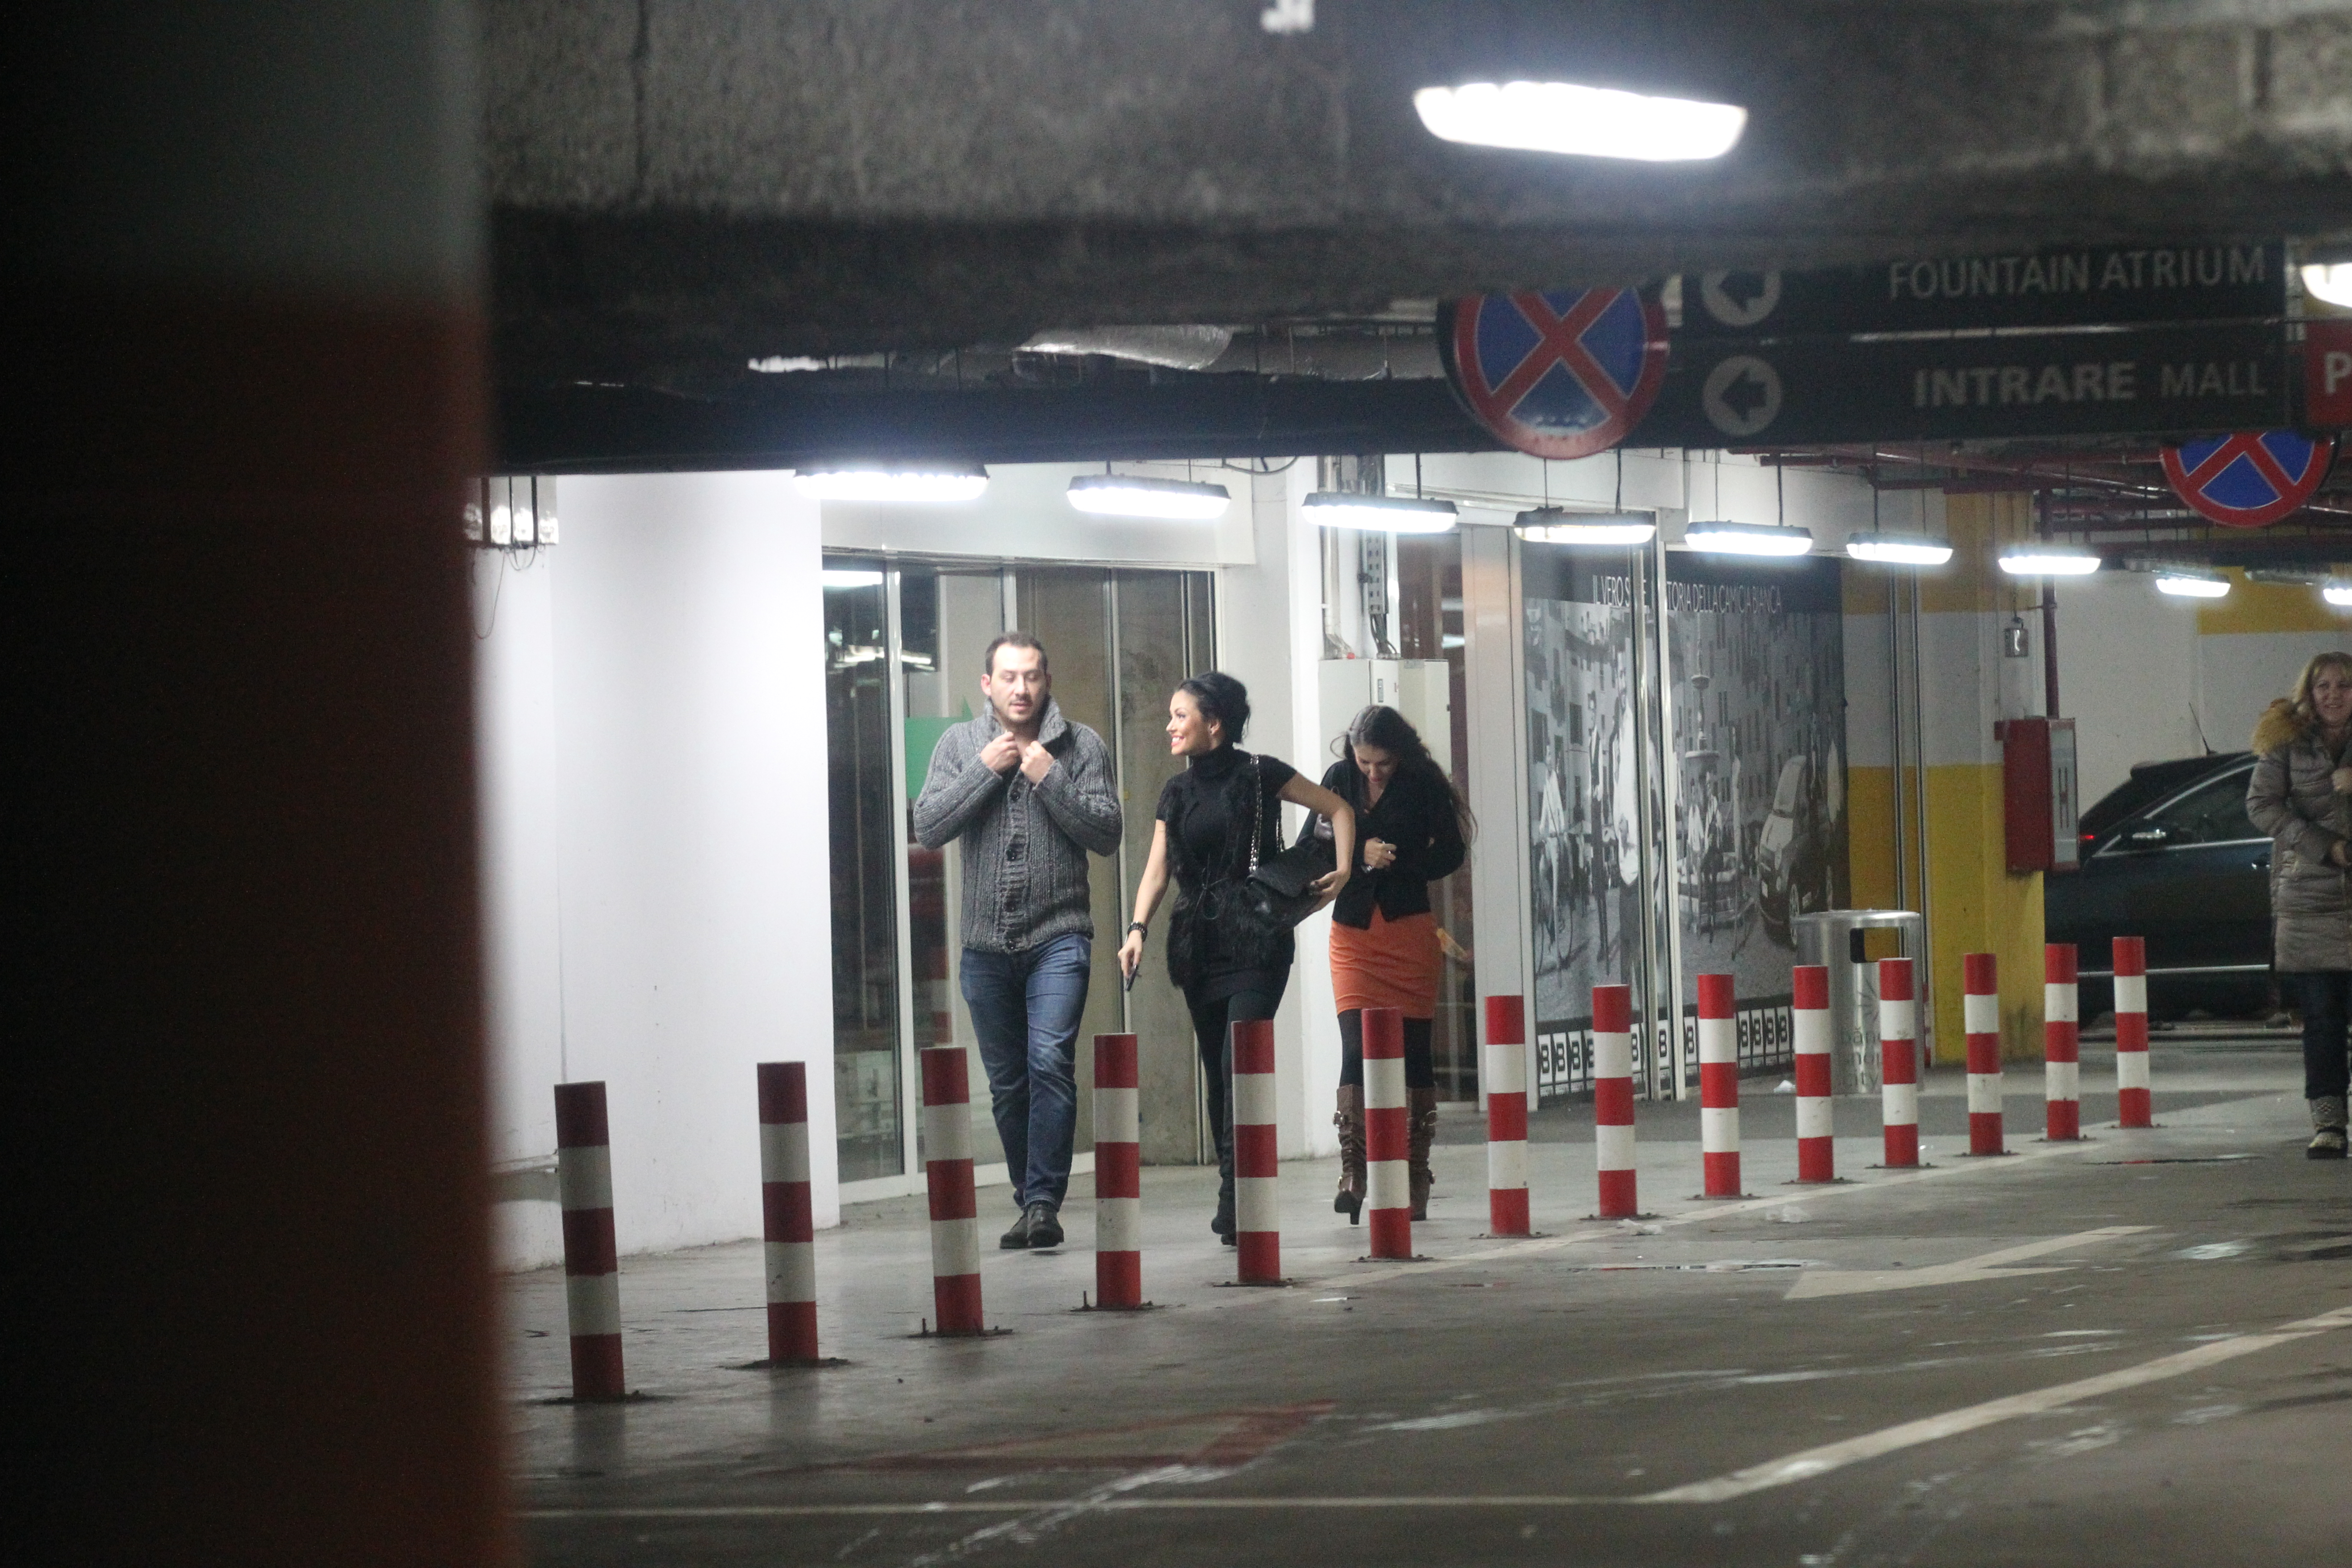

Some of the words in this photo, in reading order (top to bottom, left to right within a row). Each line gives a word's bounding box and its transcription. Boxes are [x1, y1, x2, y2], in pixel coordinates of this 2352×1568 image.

[1889, 253, 2088, 301] FOUNTAIN
[2098, 245, 2266, 289] ATRIUM
[1914, 362, 2136, 406] INTRARE
[2163, 362, 2267, 397] MALL
